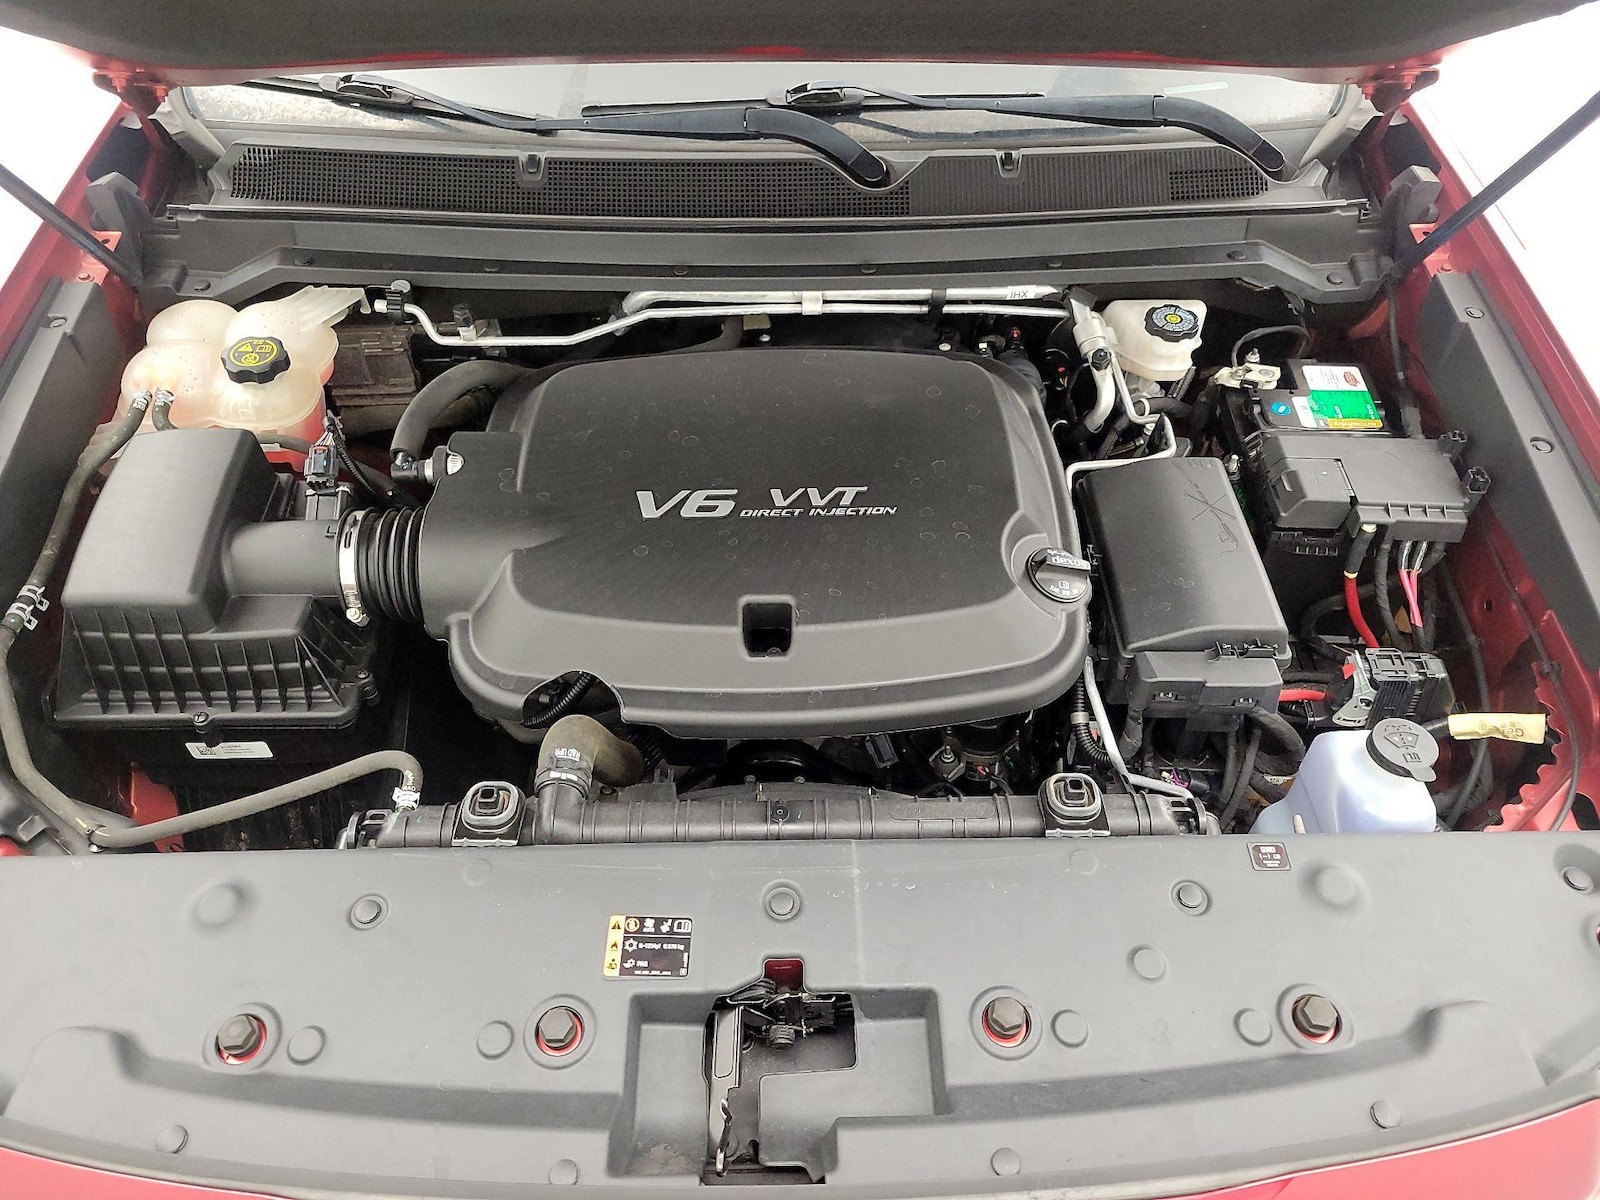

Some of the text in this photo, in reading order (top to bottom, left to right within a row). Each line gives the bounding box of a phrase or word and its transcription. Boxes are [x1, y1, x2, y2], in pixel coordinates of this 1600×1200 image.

[635, 488, 738, 519] V6
[769, 486, 868, 507] VVT
[739, 506, 898, 518] DIRECT INJECTION
